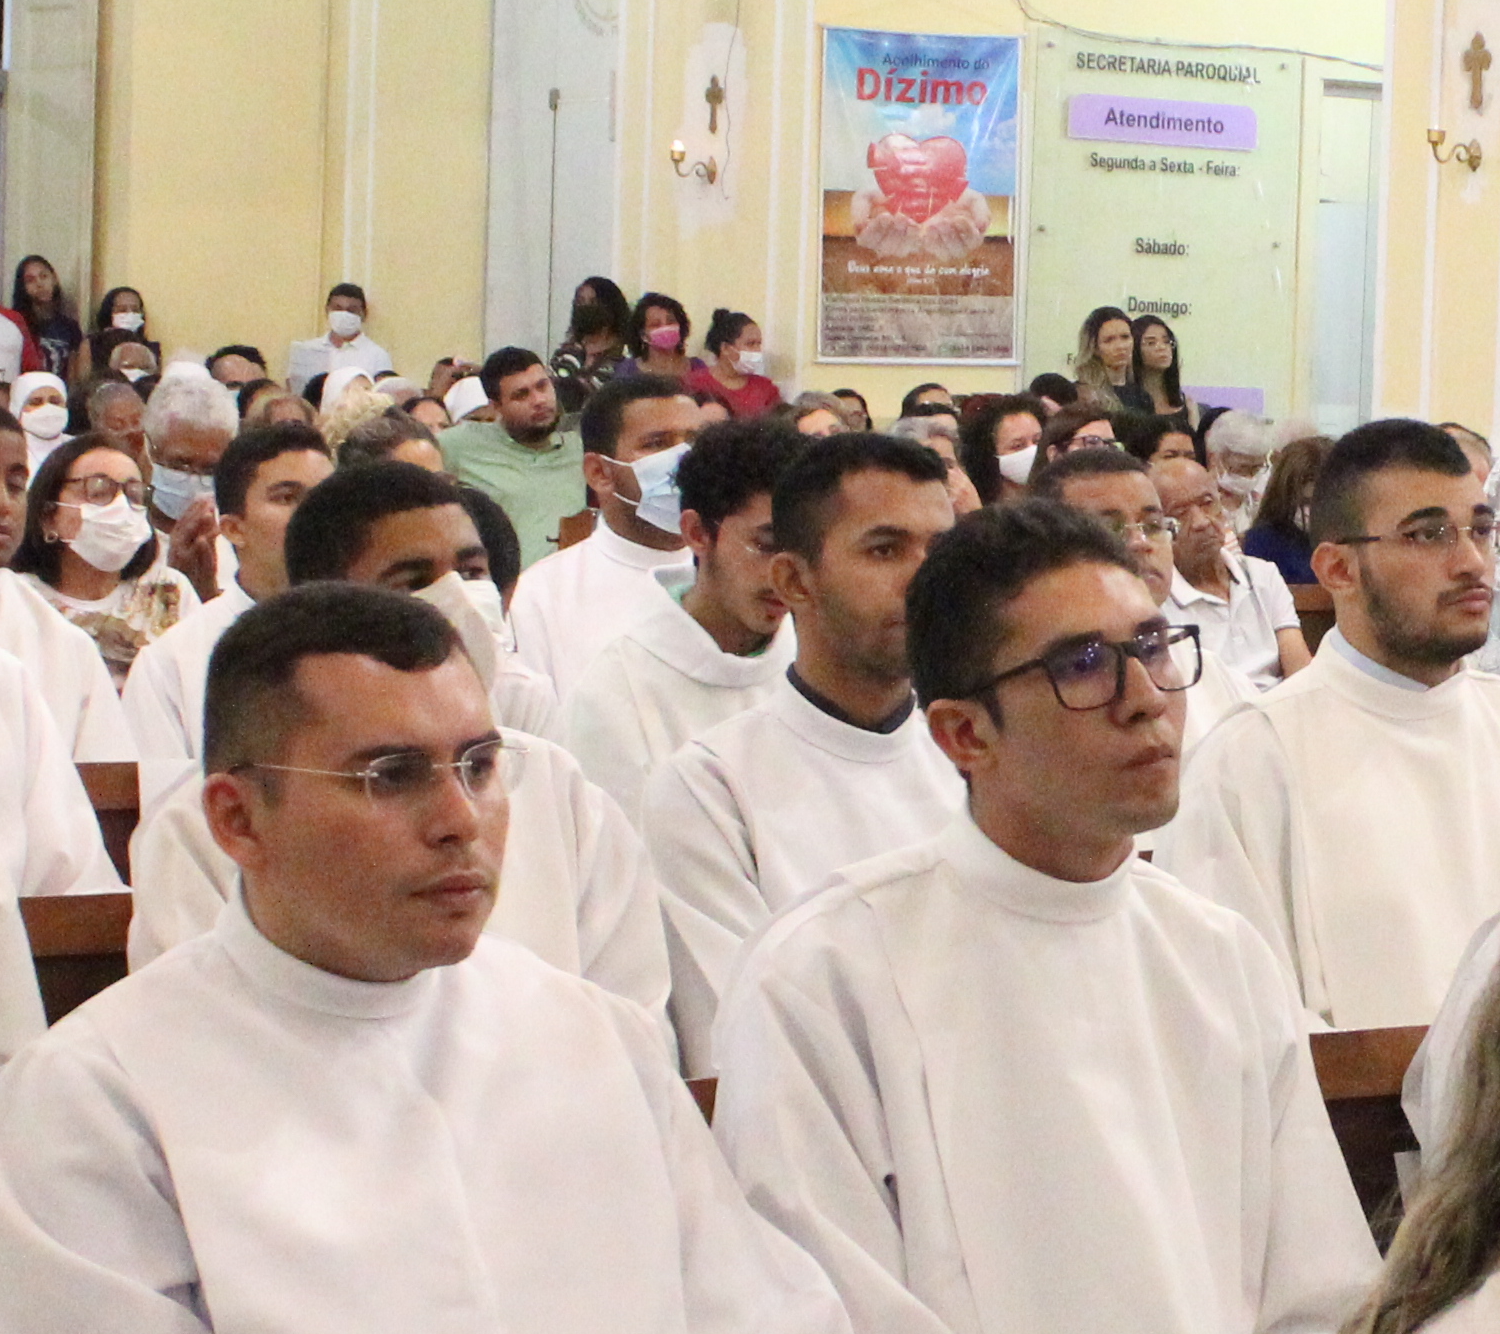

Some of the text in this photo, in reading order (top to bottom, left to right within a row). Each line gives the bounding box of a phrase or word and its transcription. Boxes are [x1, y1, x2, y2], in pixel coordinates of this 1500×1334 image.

[883, 53, 990, 70] Acolhimento do
[1076, 51, 1261, 84] SECRETARIA PAROQUIAL
[857, 68, 988, 105] Dízimo
[1104, 107, 1225, 134] Atendimento
[1090, 152, 1145, 172] Segunda
[1149, 159, 1157, 171] a
[1160, 157, 1195, 175] Sexta
[1206, 161, 1241, 177] Feira:
[1135, 237, 1190, 256] Sábado:
[1128, 296, 1192, 318] Domingo:
